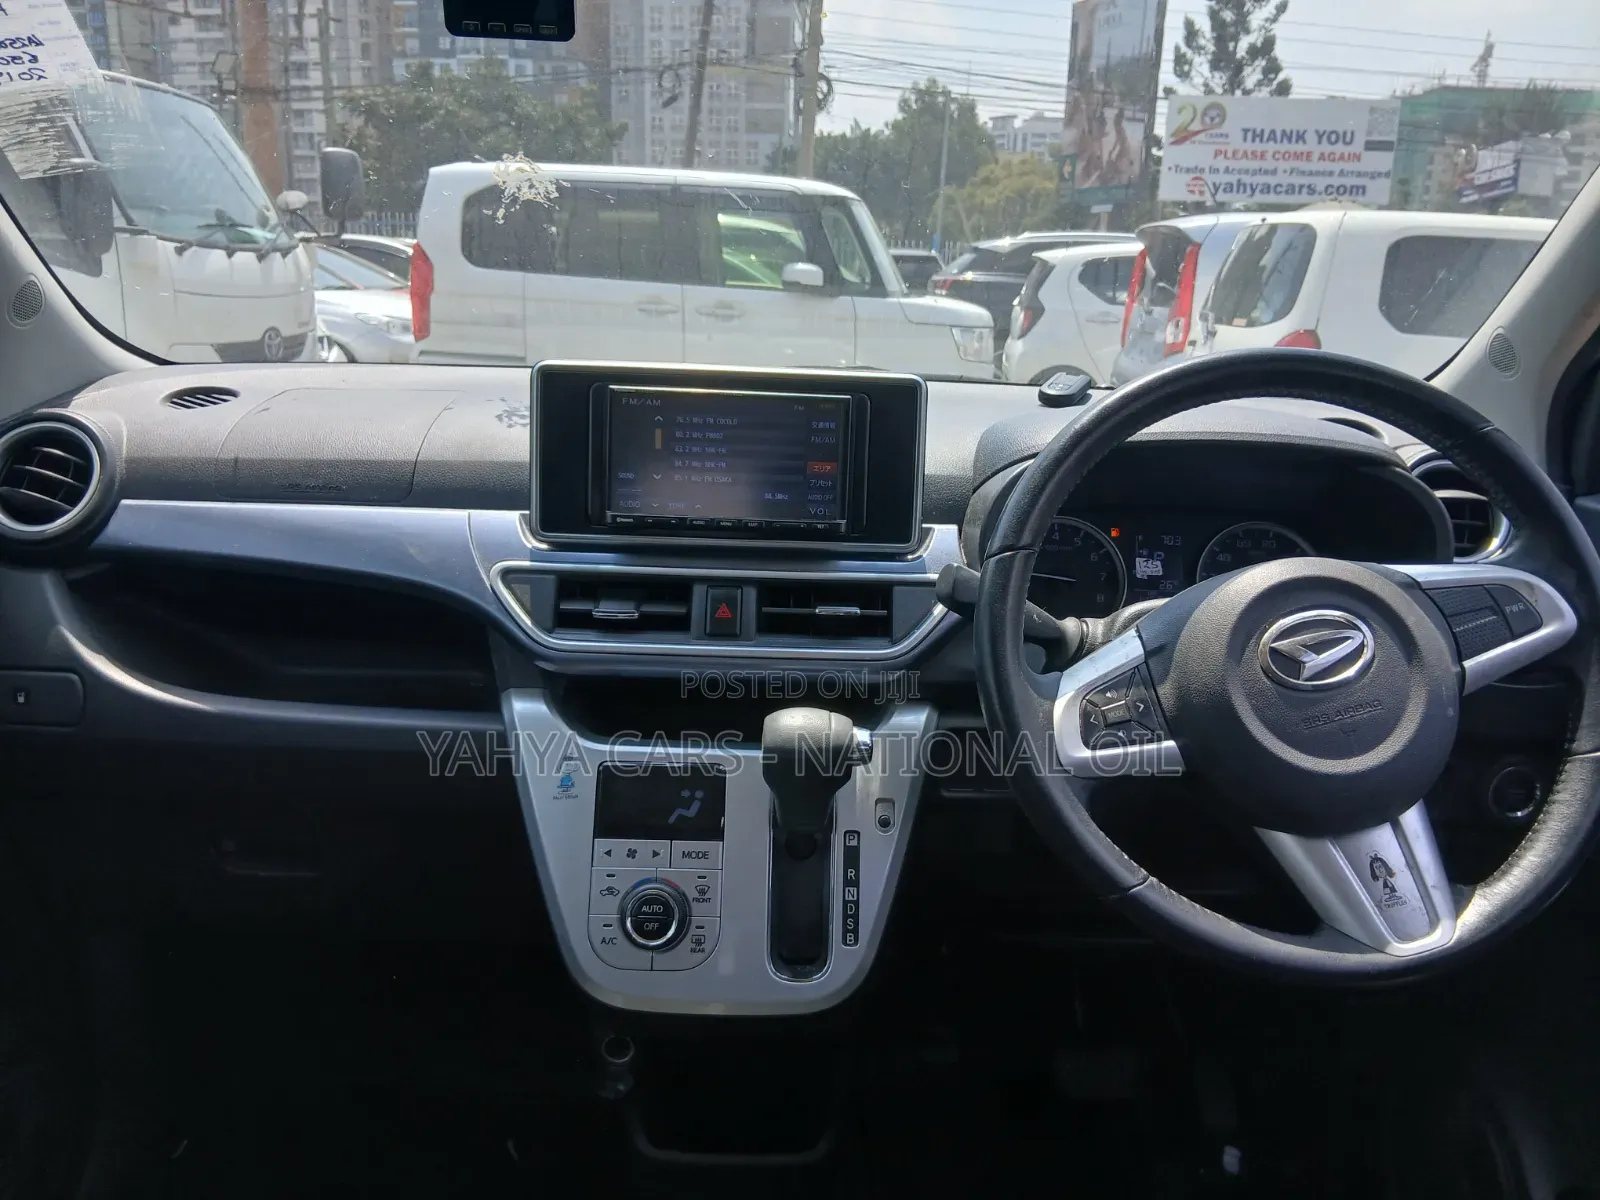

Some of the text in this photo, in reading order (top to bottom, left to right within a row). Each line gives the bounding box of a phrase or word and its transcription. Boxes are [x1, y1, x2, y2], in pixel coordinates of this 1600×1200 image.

[1240, 128, 1355, 146] THANK YOU
[1214, 149, 1361, 163] PLEASE COME AGAIN
[1174, 165, 1205, 175] Trade
[1208, 166, 1220, 175] In
[1223, 166, 1278, 178] Accepted
[1337, 168, 1391, 180] Arranged
[1212, 178, 1367, 198] yahyacars.com
[622, 398, 661, 407] FM/AM
[810, 436, 836, 444] FM/AM
[620, 500, 641, 509] AUDIO
[1052, 532, 1060, 541] 4
[1074, 537, 1081, 546] 5
[1090, 552, 1098, 562] 6
[1505, 602, 1525, 613] PWR
[1107, 708, 1126, 718] MODE
[1301, 699, 1383, 726] SRS AIRBAG
[847, 834, 856, 845] P
[682, 850, 710, 860] MODE
[847, 869, 856, 880] R
[847, 889, 855, 900] N
[641, 904, 663, 913] AUTO
[847, 903, 855, 914] D
[643, 922, 660, 931] OFF
[846, 918, 855, 929] S
[600, 936, 618, 946] A/C
[846, 933, 855, 944] B
